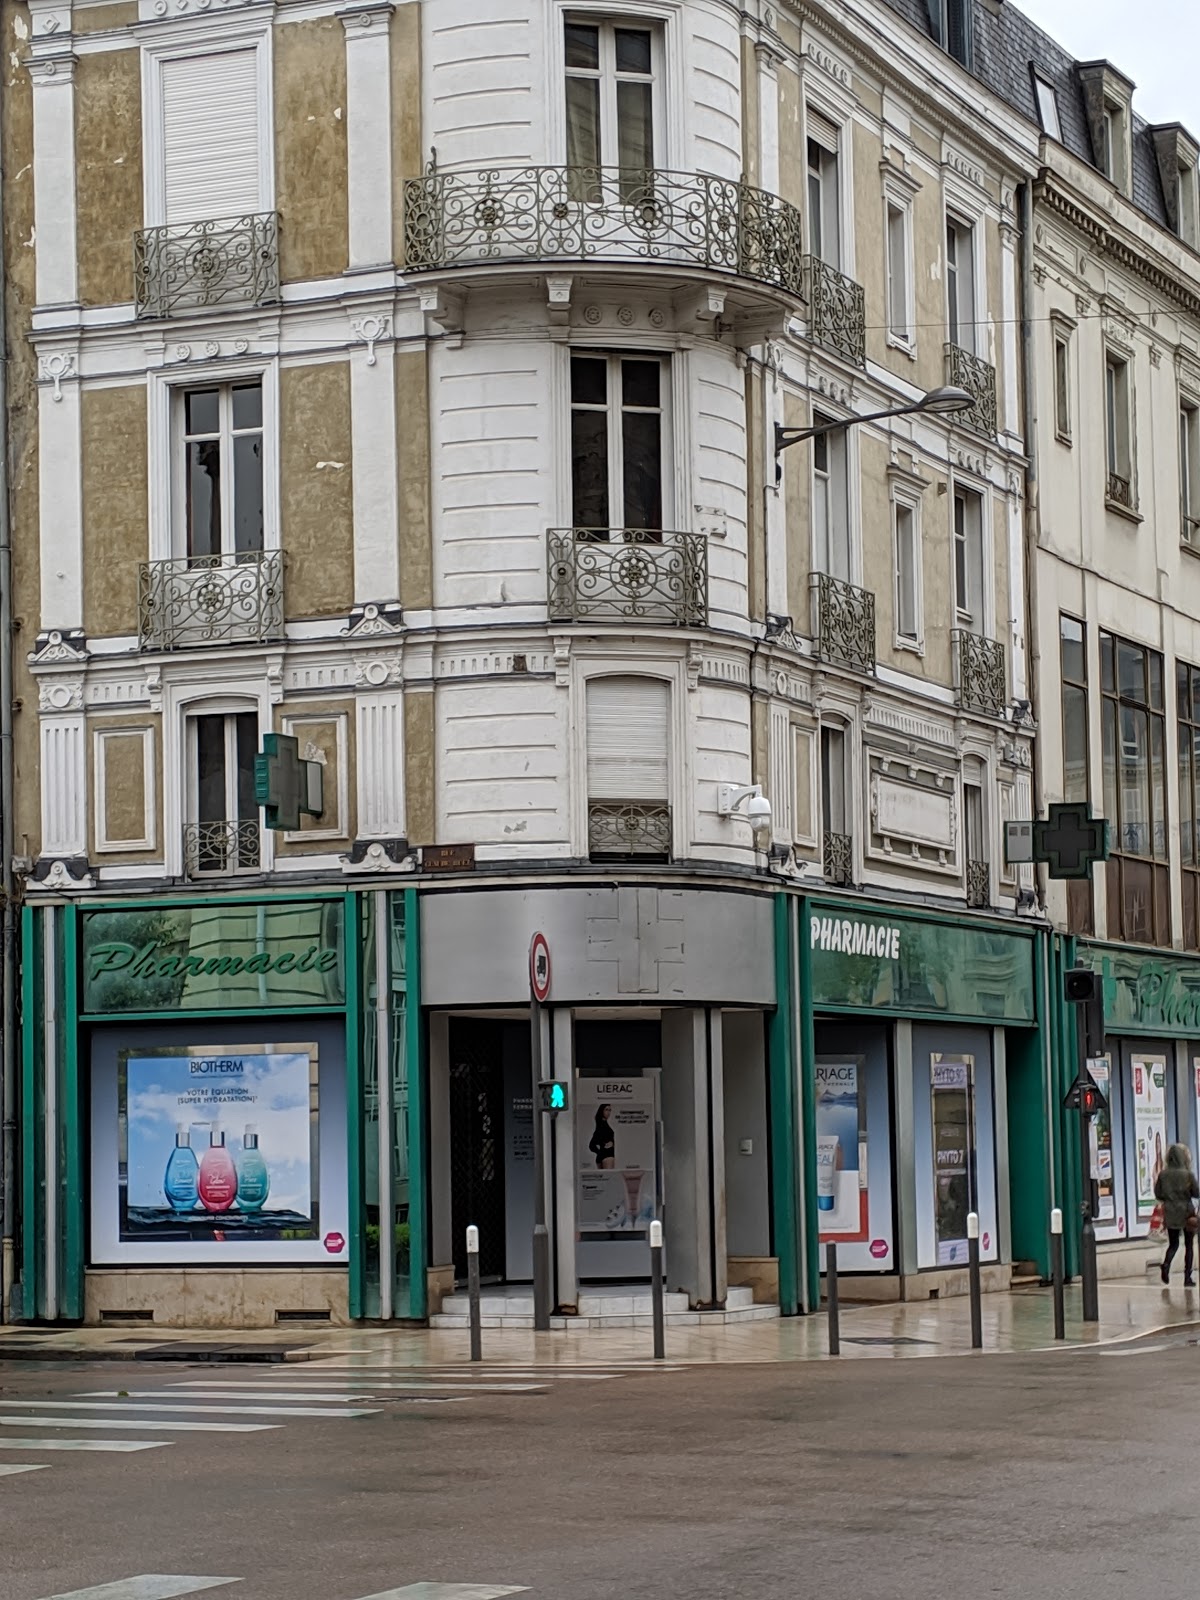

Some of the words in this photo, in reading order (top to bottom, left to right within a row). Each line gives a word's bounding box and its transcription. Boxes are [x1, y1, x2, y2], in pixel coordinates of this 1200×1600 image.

[810, 916, 900, 960] PHARMACIE
[89, 940, 337, 981] Pharmacie
[190, 1061, 243, 1073] BIOTHERM
[814, 1068, 854, 1082] RIAGE
[597, 1084, 632, 1093] LIERAC
[937, 1150, 958, 1164] PHYTO
